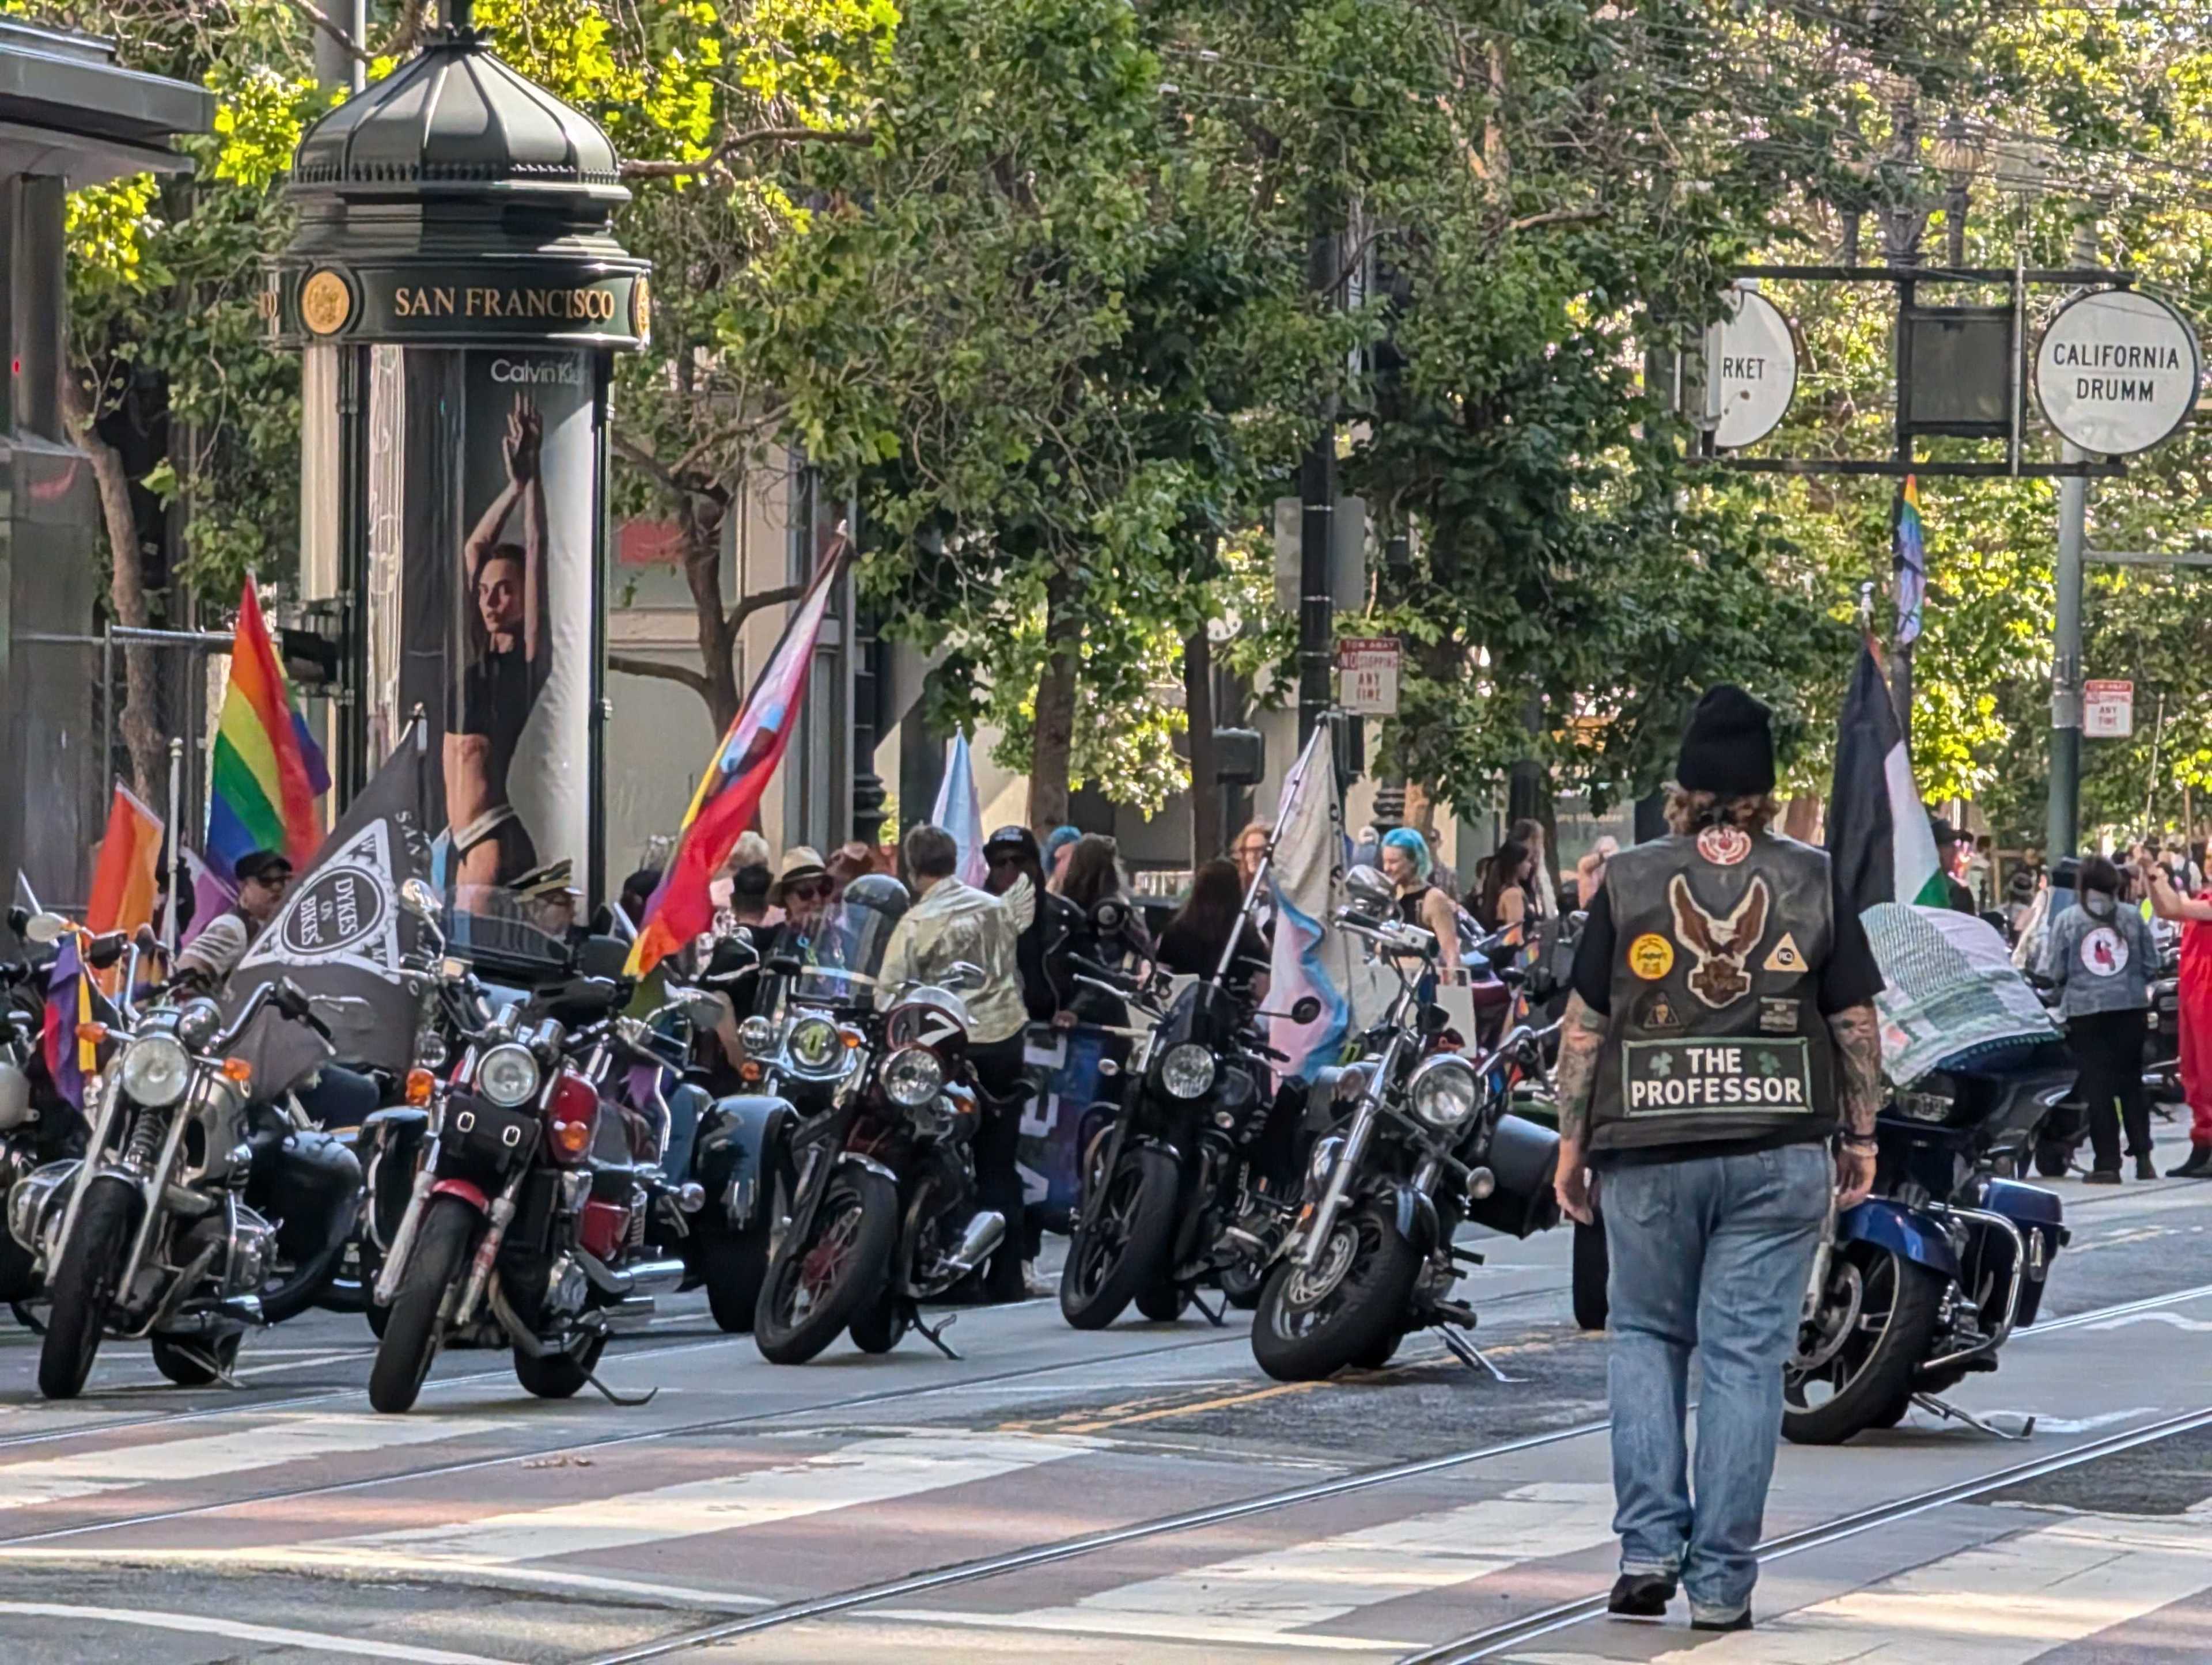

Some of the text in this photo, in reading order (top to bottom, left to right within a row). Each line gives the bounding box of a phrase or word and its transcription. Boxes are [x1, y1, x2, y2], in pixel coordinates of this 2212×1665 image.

[395, 287, 615, 319] SAN FRANCISCO
[1722, 356, 1766, 380] RKET
[2054, 343, 2179, 369] CALIFORNIA
[491, 358, 556, 384] Calvin
[2077, 378, 2154, 402] DRUMM
[300, 894, 320, 946] BIKES
[335, 877, 359, 936] DYKES
[1685, 1046, 1743, 1074] THE
[1631, 1077, 1804, 1108] PROFESSOR
